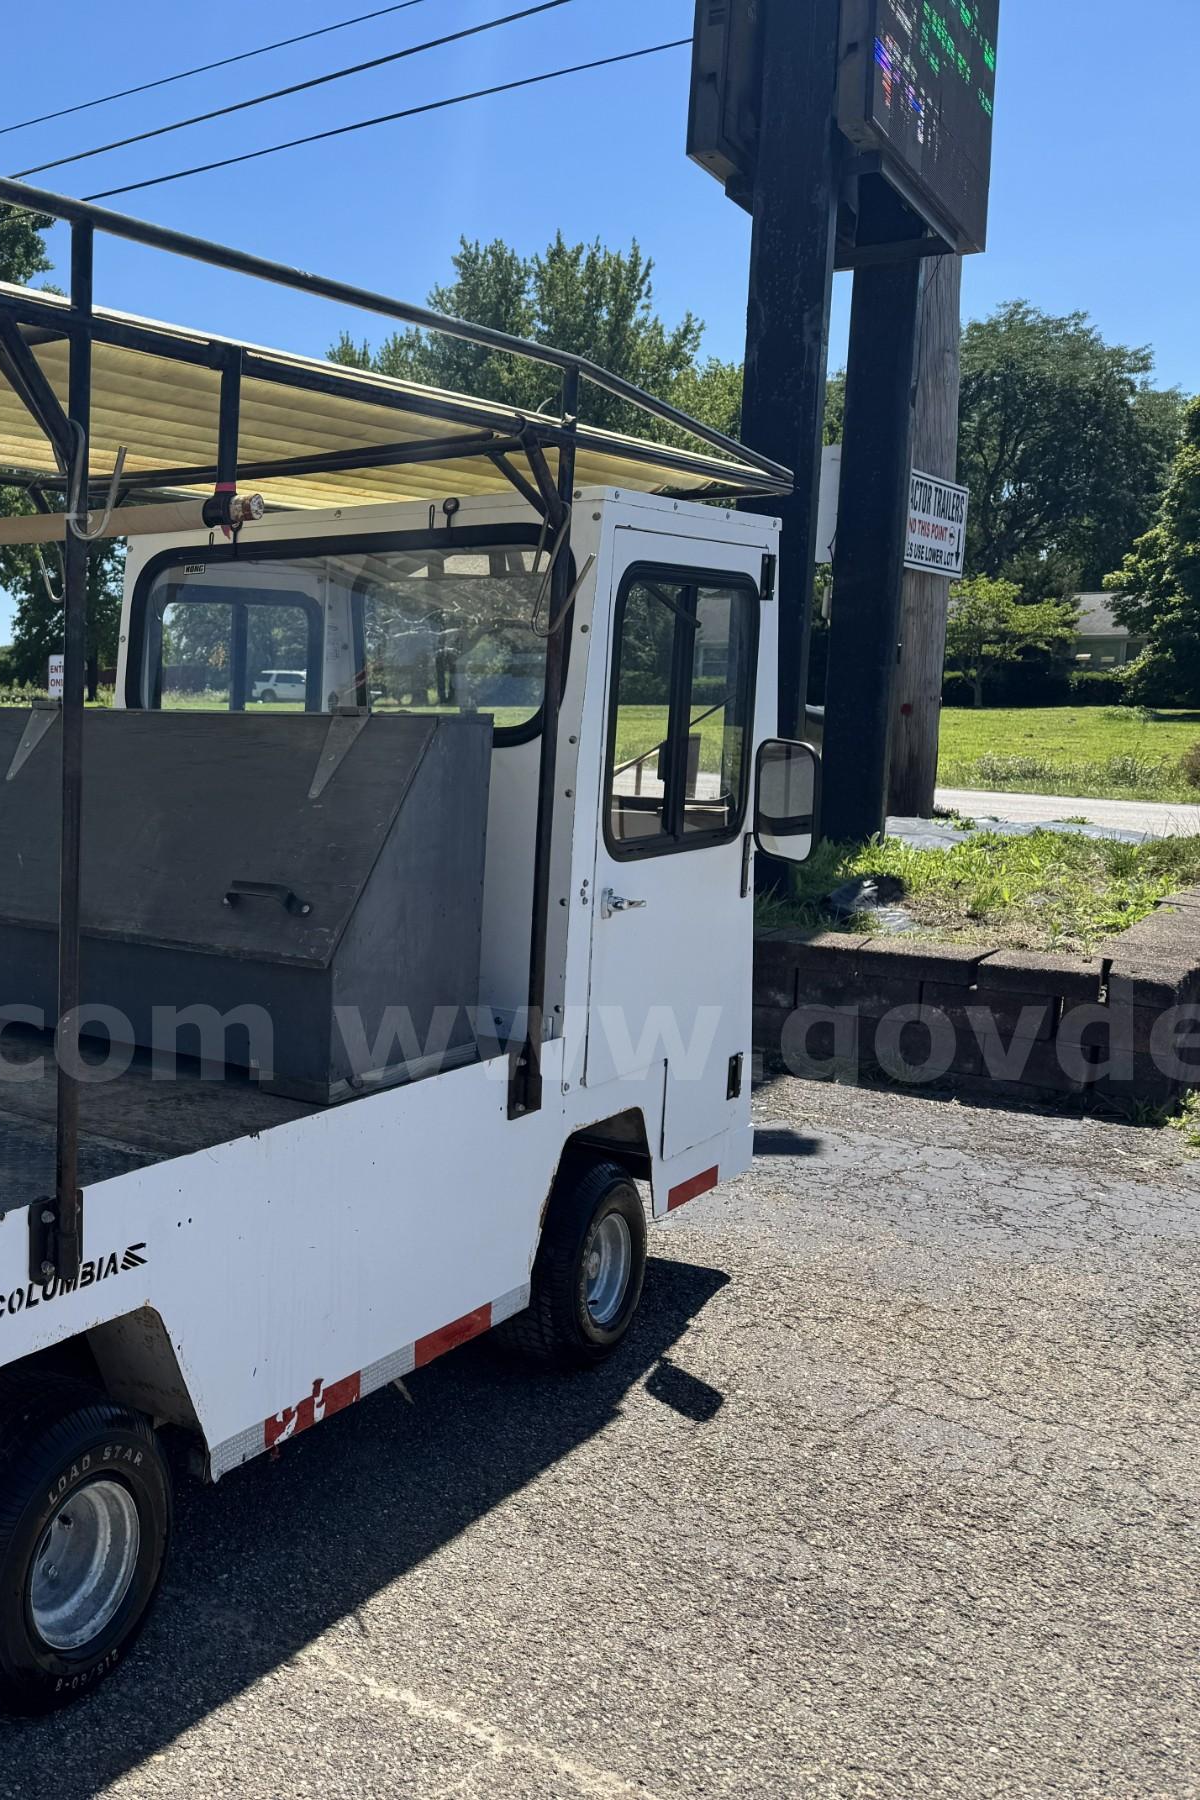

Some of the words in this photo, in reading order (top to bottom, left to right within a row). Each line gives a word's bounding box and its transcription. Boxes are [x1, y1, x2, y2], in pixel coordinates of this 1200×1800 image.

[933, 487, 965, 524] TRAILERS
[918, 519, 931, 539] THIS
[931, 523, 948, 541] POINT
[913, 543, 925, 560] USE
[925, 546, 943, 565] LOWER
[944, 550, 954, 567] LOT
[48, 1454, 91, 1505] LOAD
[102, 1446, 143, 1466] STAR
